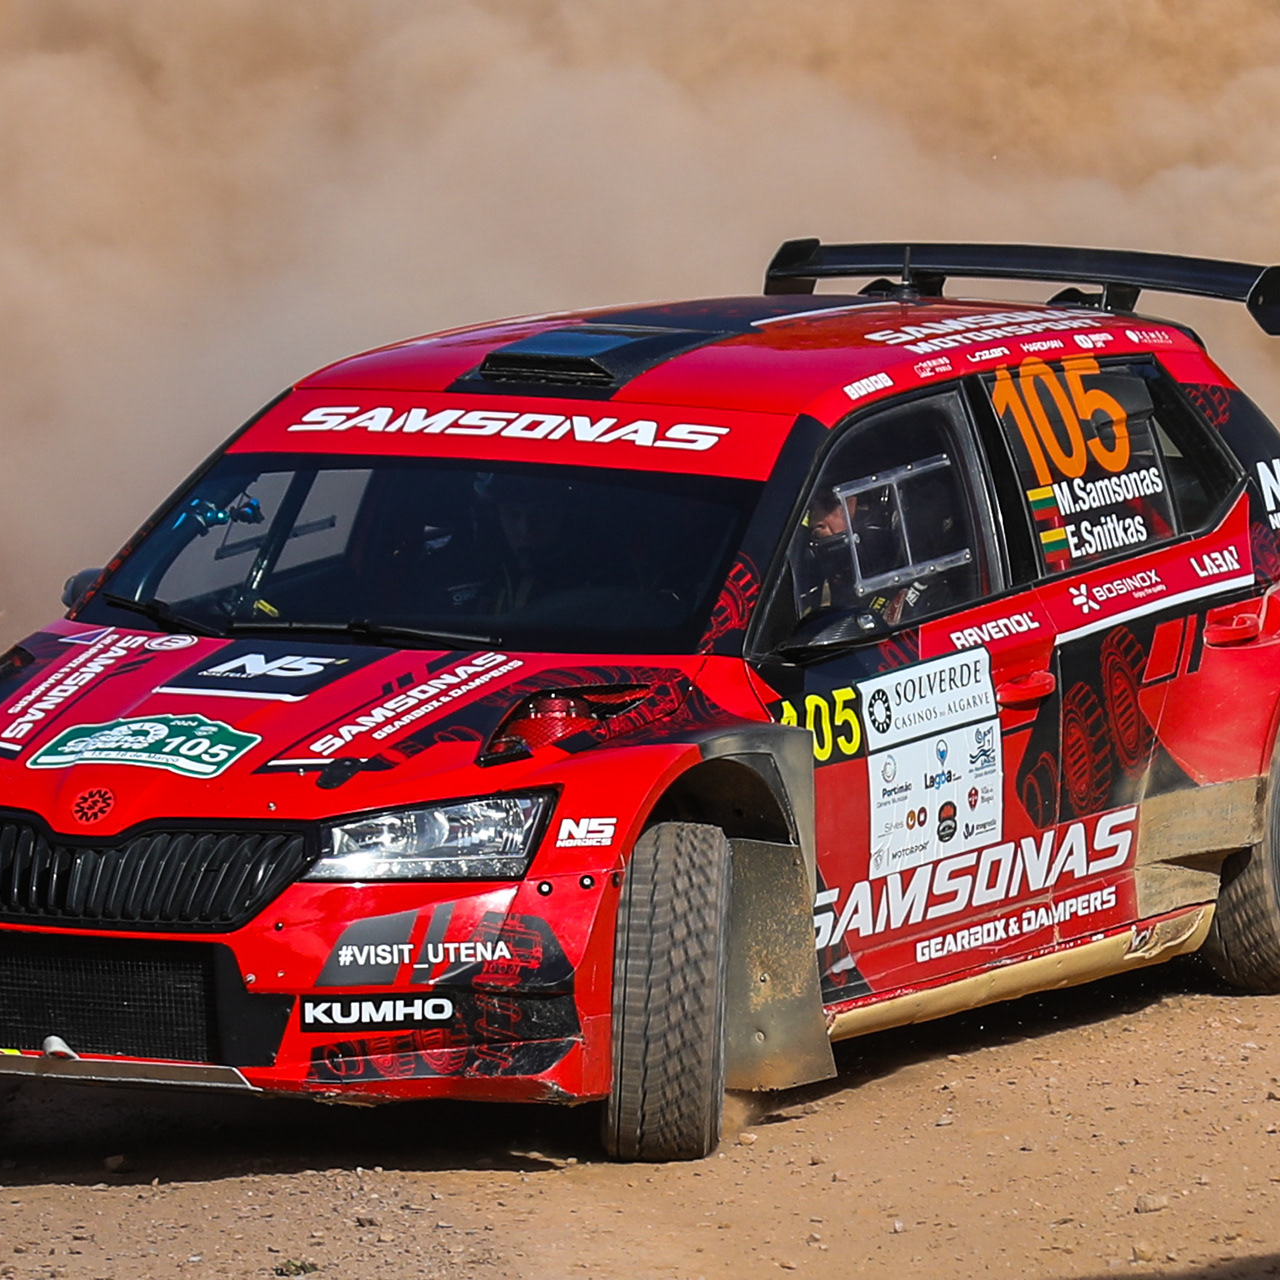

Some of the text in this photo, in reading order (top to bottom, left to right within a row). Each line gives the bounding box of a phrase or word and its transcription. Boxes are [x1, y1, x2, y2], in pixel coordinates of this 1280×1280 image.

[904, 318, 1102, 354] MOTORSPORT
[287, 406, 731, 451] SAMSONAS
[992, 352, 1131, 486] 105
[1052, 466, 1164, 517] M.Samsonas
[1064, 513, 1148, 559] E.Snitkas
[1091, 568, 1162, 602] BOSINOX
[949, 610, 1041, 650] RAVENOL
[206, 653, 337, 677] N5
[894, 659, 983, 707] SOLVERDE
[1, 635, 149, 739] SAMSONAS
[309, 651, 508, 756] SAMSONAS
[371, 699, 443, 740] GEARBOX
[448, 659, 524, 698] DAMPERS
[894, 706, 939, 731] CASINOS
[947, 691, 991, 715] ALGARVE
[161, 735, 237, 763] 105
[924, 769, 953, 790] Lagoa
[555, 837, 613, 848] NORDICS
[558, 817, 618, 840] N5
[813, 805, 1138, 950] SAMSONAS
[915, 885, 1118, 963] GEARBOX & DAMPERS
[338, 940, 512, 969] #VISIT_UTENA
[304, 998, 454, 1024] KUMHO
